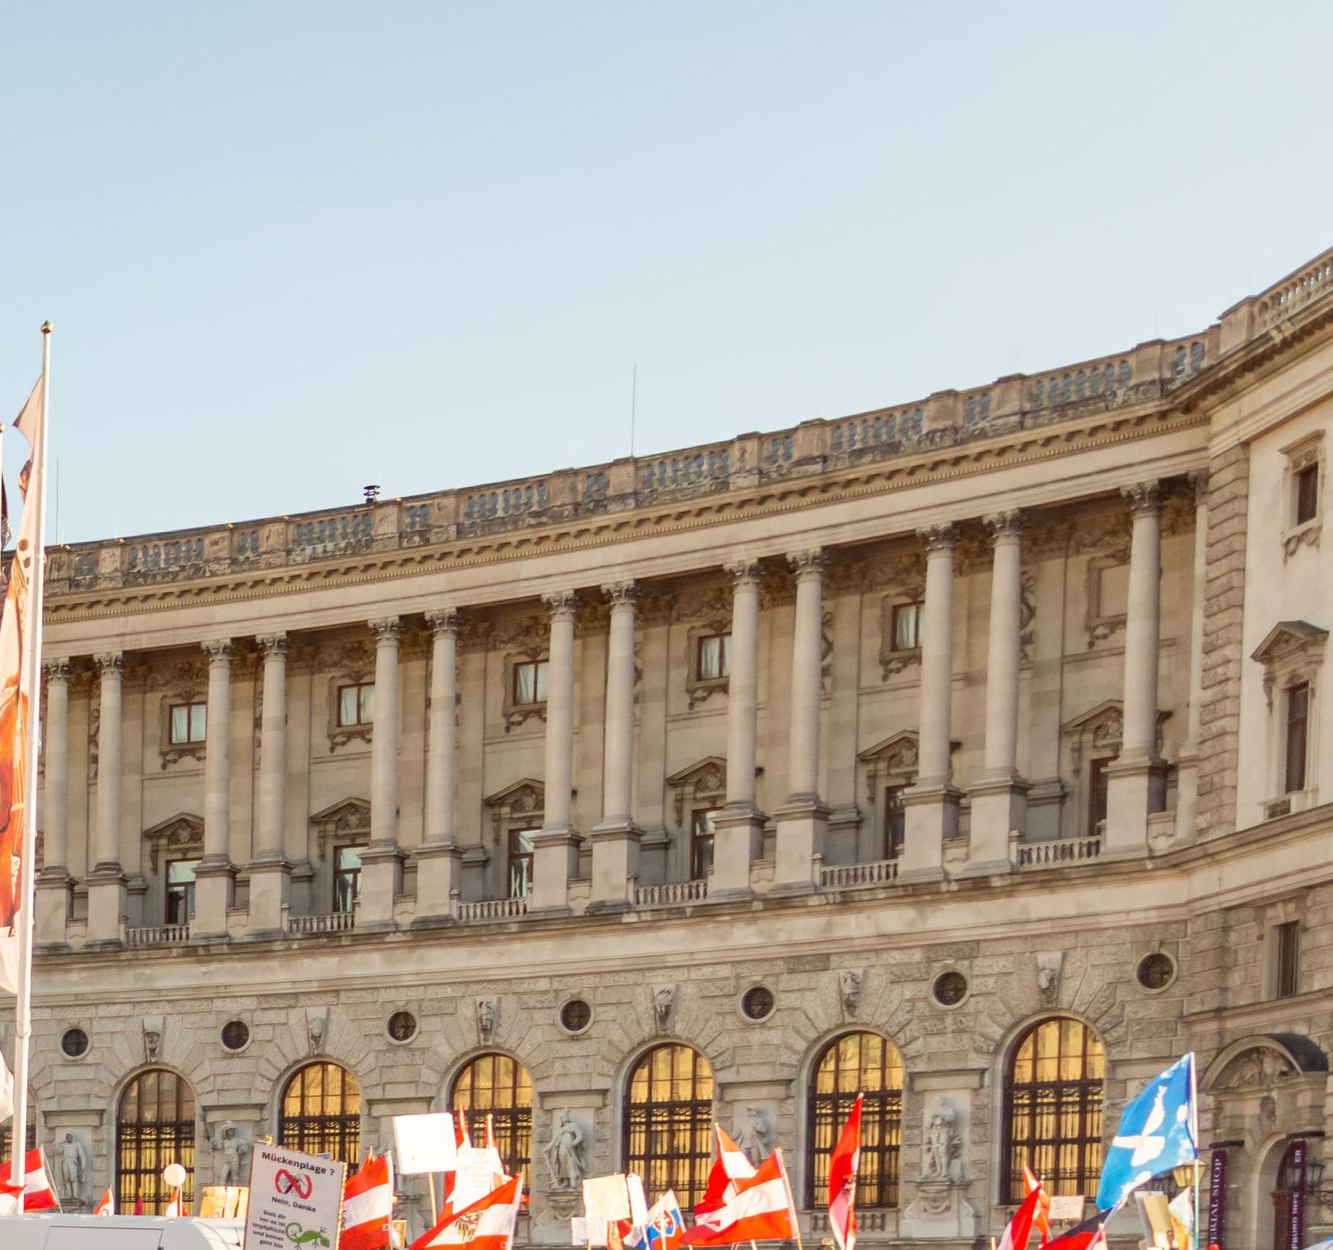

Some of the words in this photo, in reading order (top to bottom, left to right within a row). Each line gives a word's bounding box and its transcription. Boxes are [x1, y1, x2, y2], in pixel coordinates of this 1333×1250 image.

[261, 1151, 327, 1175] Mückenplage
[329, 1168, 335, 1176] ?
[1212, 1158, 1222, 1197] SHOP
[271, 1196, 291, 1208] Nein,
[292, 1201, 317, 1213] Danke
